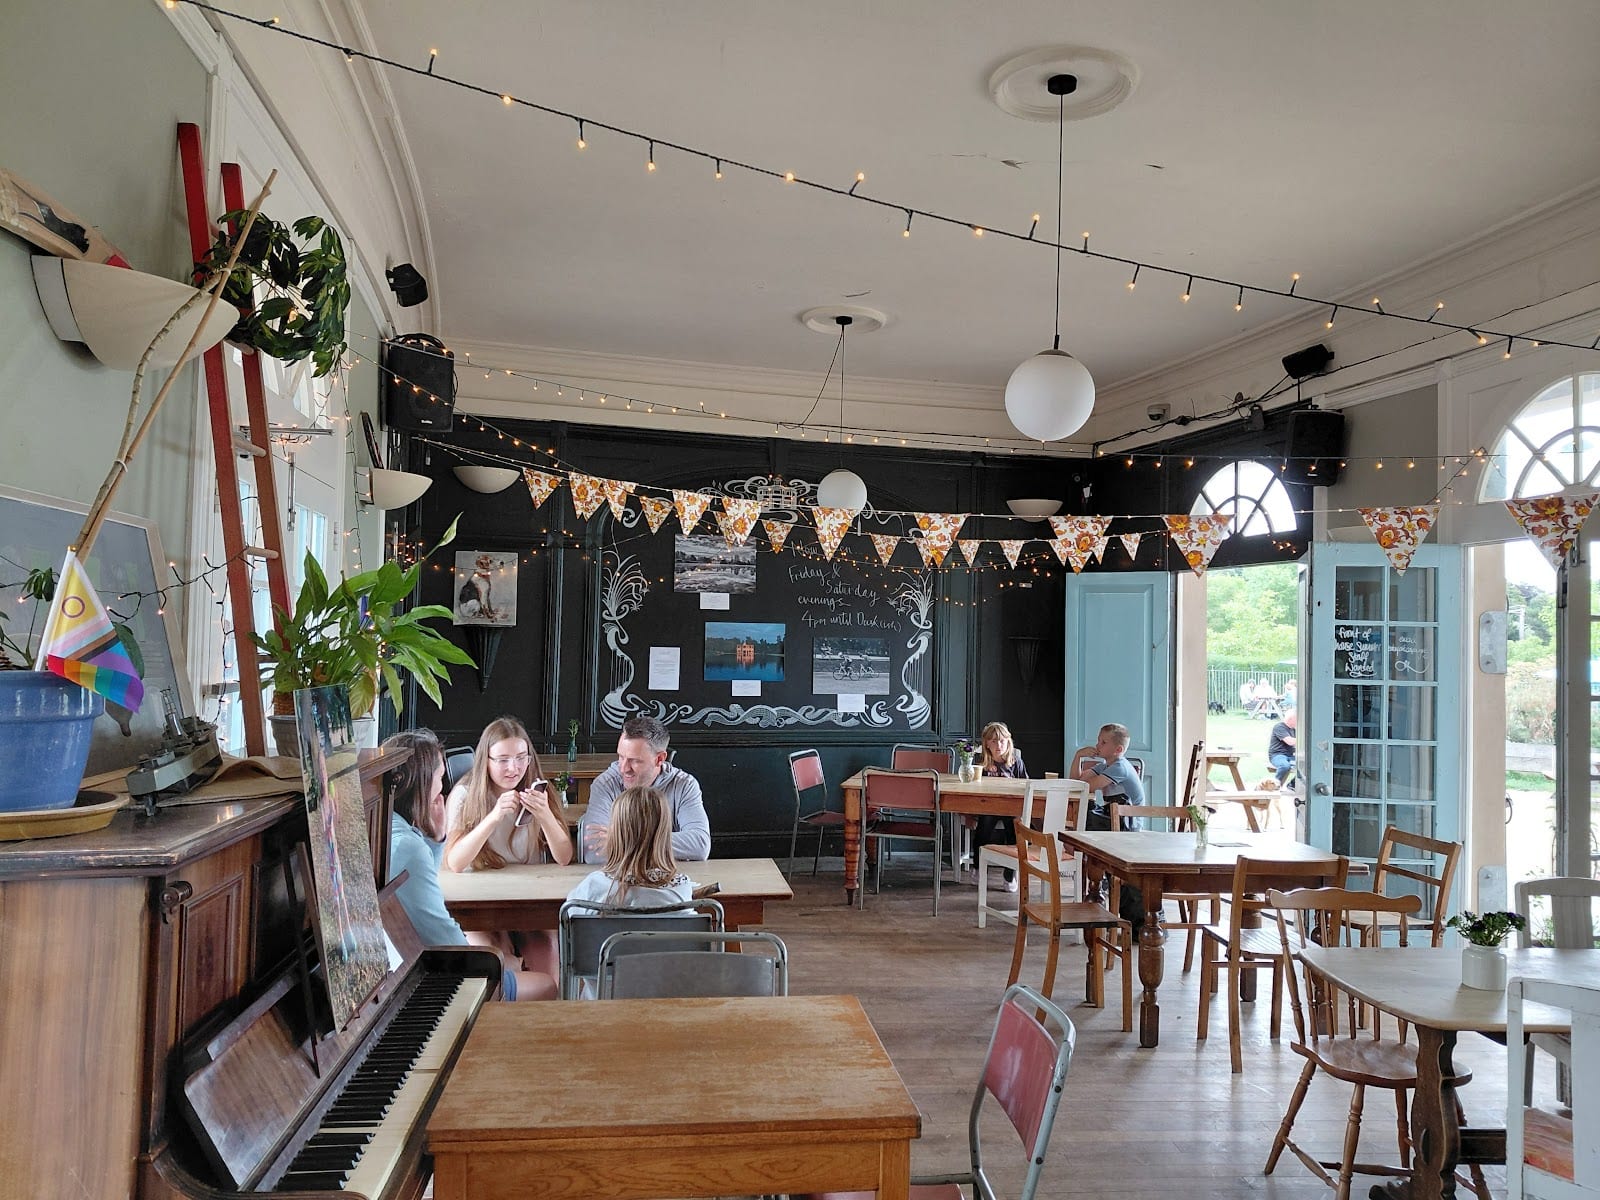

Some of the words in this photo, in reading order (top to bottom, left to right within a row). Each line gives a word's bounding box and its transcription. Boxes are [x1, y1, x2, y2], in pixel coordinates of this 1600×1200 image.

[788, 564, 830, 587] Friday
[831, 562, 842, 578] &
[825, 580, 880, 608] Saturday
[797, 595, 851, 612] evenings
[801, 610, 826, 629] 4pm
[830, 612, 853, 627] until
[1362, 627, 1372, 641] of
[1348, 651, 1370, 664] Staff
